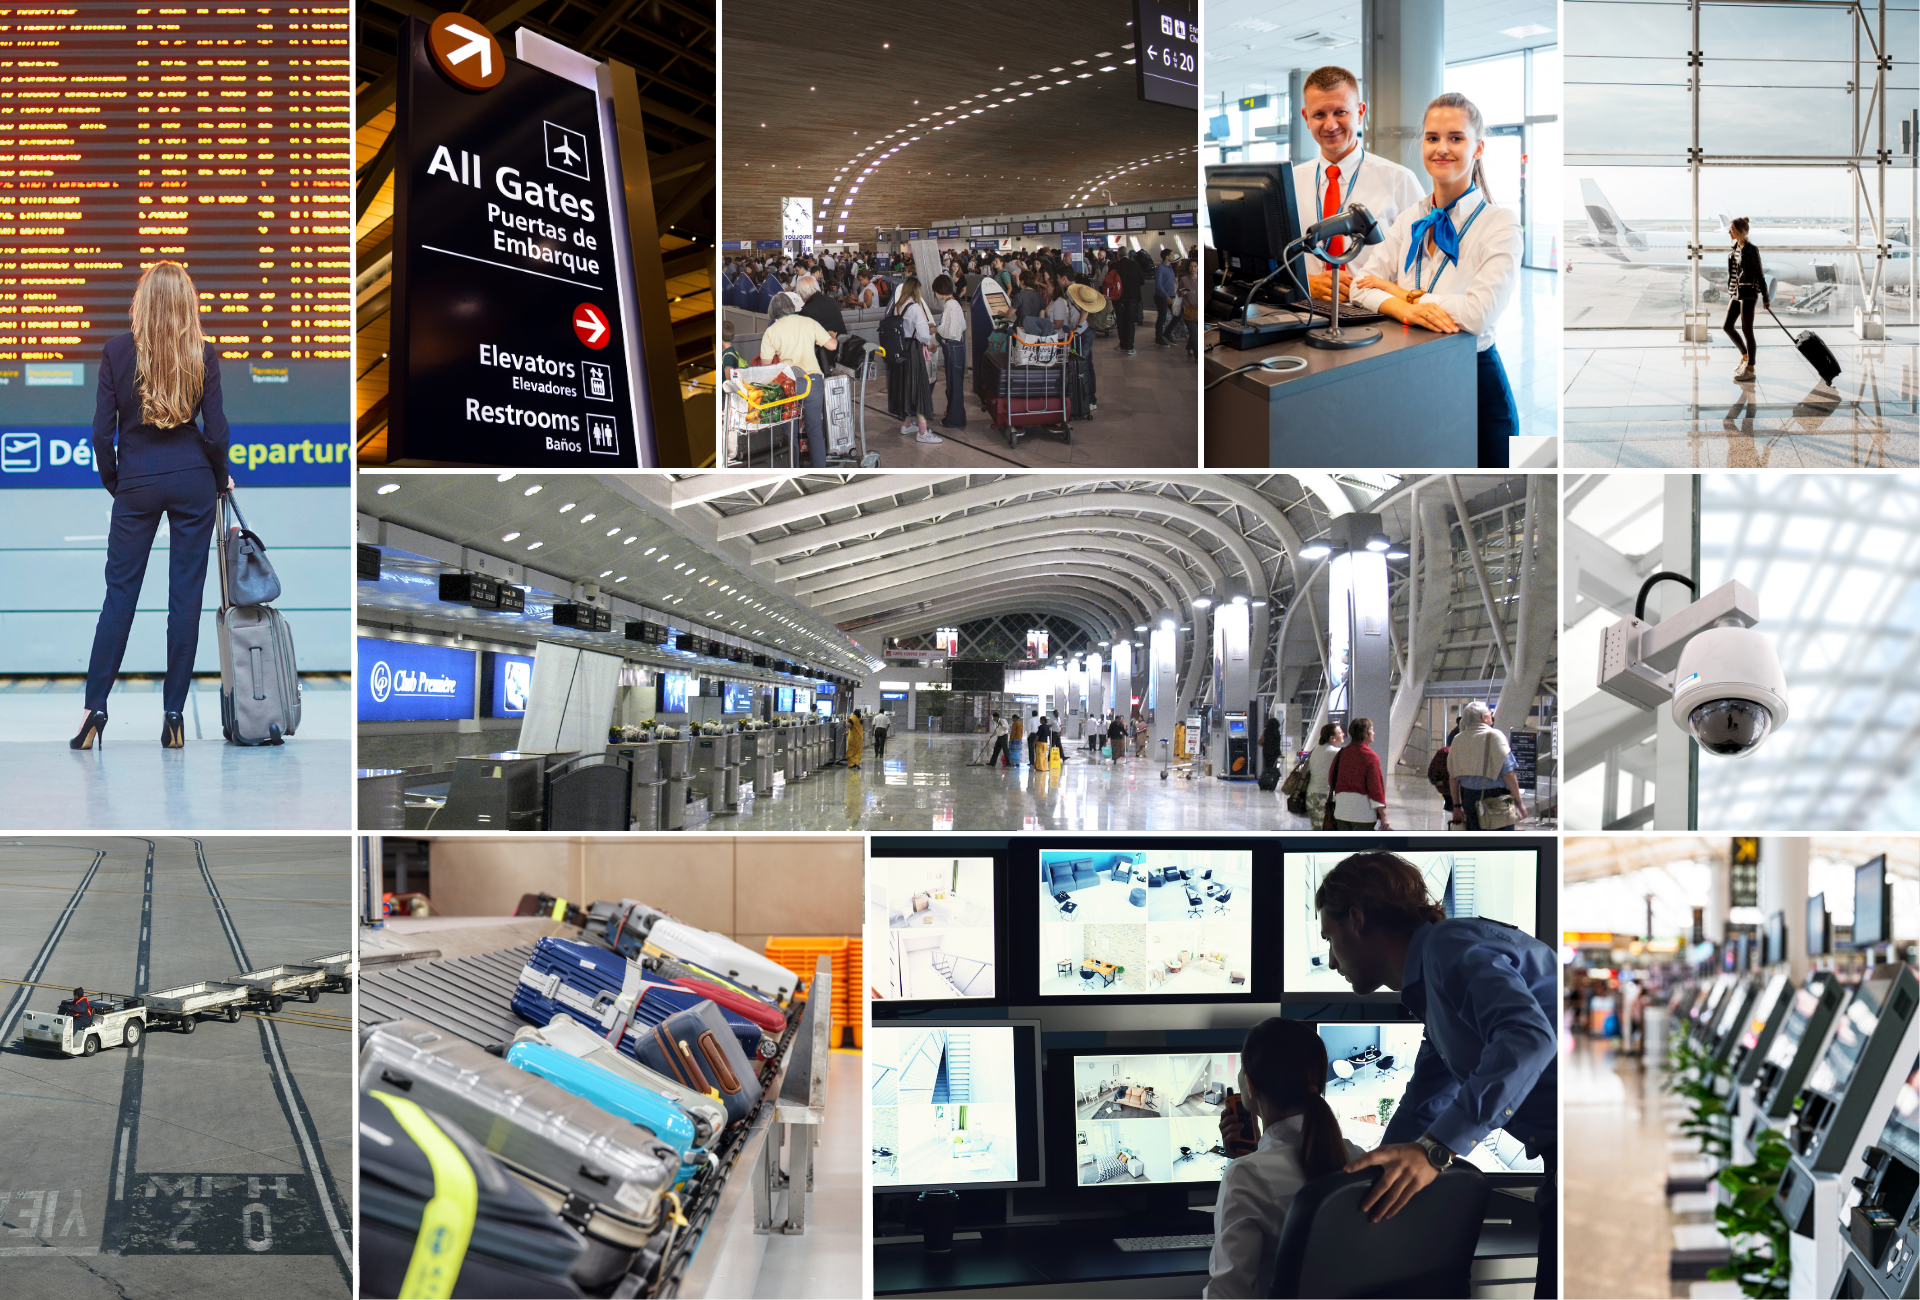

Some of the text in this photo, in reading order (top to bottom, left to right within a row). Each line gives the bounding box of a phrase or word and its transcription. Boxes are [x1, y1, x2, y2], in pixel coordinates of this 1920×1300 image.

[1163, 48, 1171, 66] 6
[1180, 52, 1194, 72] 20
[427, 145, 595, 222] All Gates
[488, 202, 597, 250] Puertas de
[494, 229, 600, 275] Embarque
[480, 343, 576, 378] Elevators
[512, 376, 577, 397] Elevadores
[466, 397, 580, 432] Restrooms
[228, 438, 351, 471] epartur
[545, 436, 582, 453] Baños
[394, 669, 417, 692] Club
[144, 1176, 289, 1199] MPH
